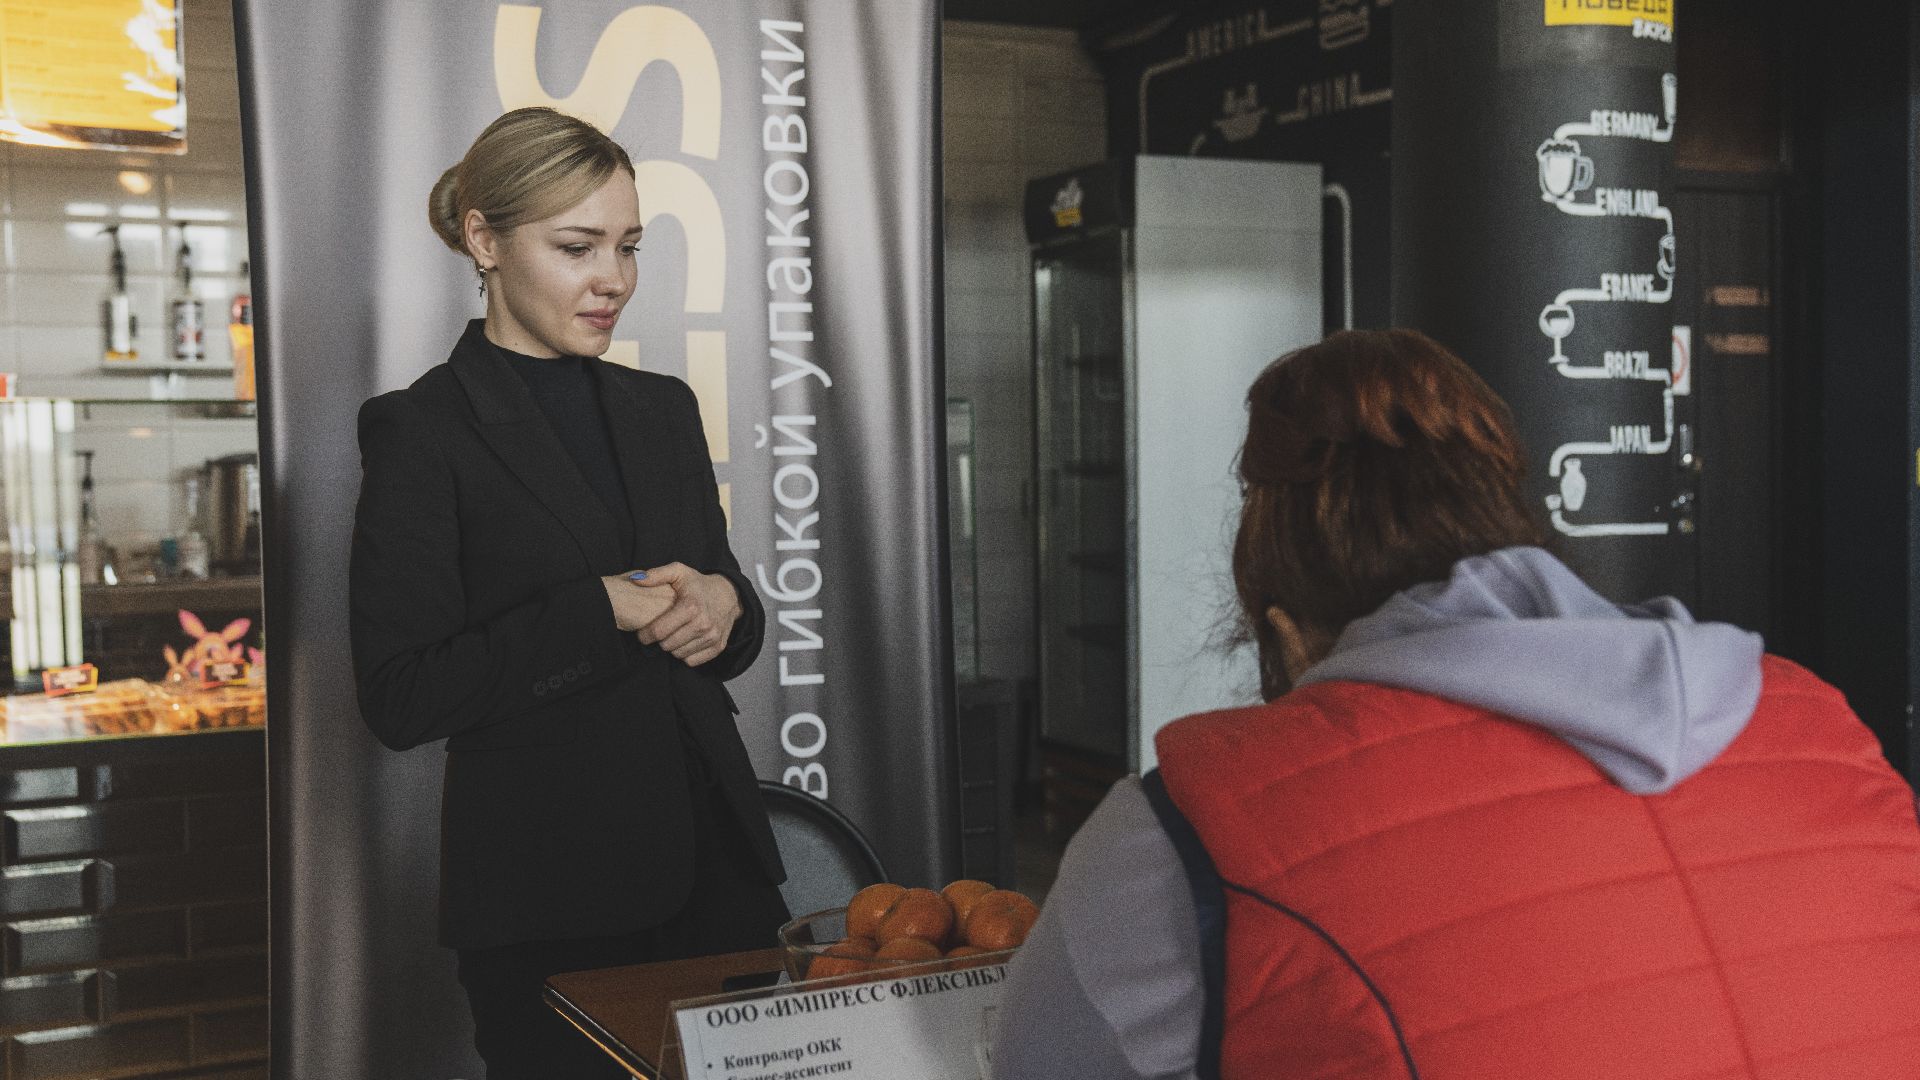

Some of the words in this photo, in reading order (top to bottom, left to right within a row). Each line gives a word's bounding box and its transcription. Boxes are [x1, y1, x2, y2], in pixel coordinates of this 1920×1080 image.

[760, 19, 832, 391] упаковки
[1596, 187, 1659, 217] ENGLAND
[1601, 272, 1654, 301] FRANCE
[1603, 350, 1649, 379] BRAZIL
[1610, 425, 1650, 453] JAPAN
[755, 414, 825, 686] гибкой
[706, 1003, 759, 1028] ООО
[764, 984, 886, 1018] «ИМПРЕСС
[723, 1048, 804, 1071] Контролер
[806, 1037, 842, 1056] ОКК
